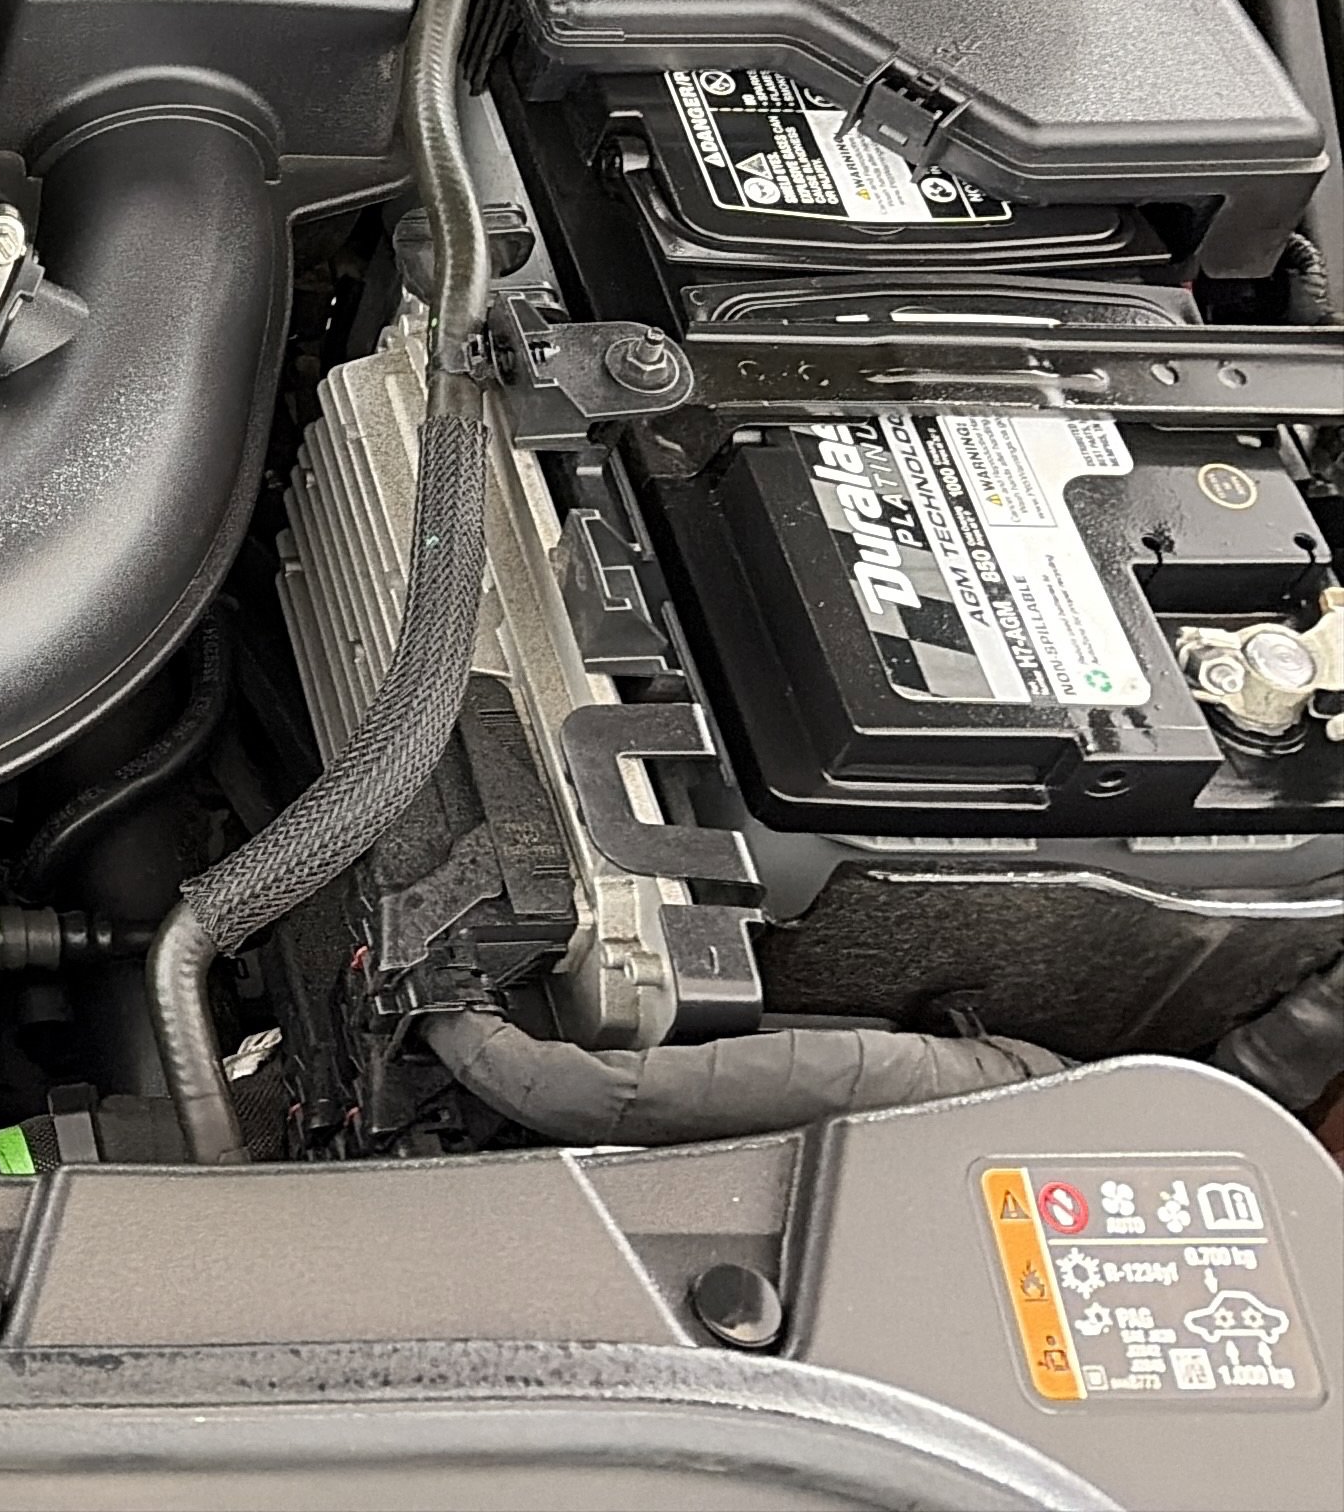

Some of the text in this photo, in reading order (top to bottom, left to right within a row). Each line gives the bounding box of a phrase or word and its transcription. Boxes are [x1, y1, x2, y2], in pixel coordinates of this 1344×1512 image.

[766, 115, 784, 132] CAN
[824, 190, 840, 204] OR
[954, 423, 995, 490] WARNING:
[938, 467, 965, 496] 1000
[970, 549, 1001, 582] 850
[948, 566, 989, 626] AGM
[991, 601, 1039, 667] H7-AGM
[1012, 575, 1076, 694] NON-SPILLABLE
